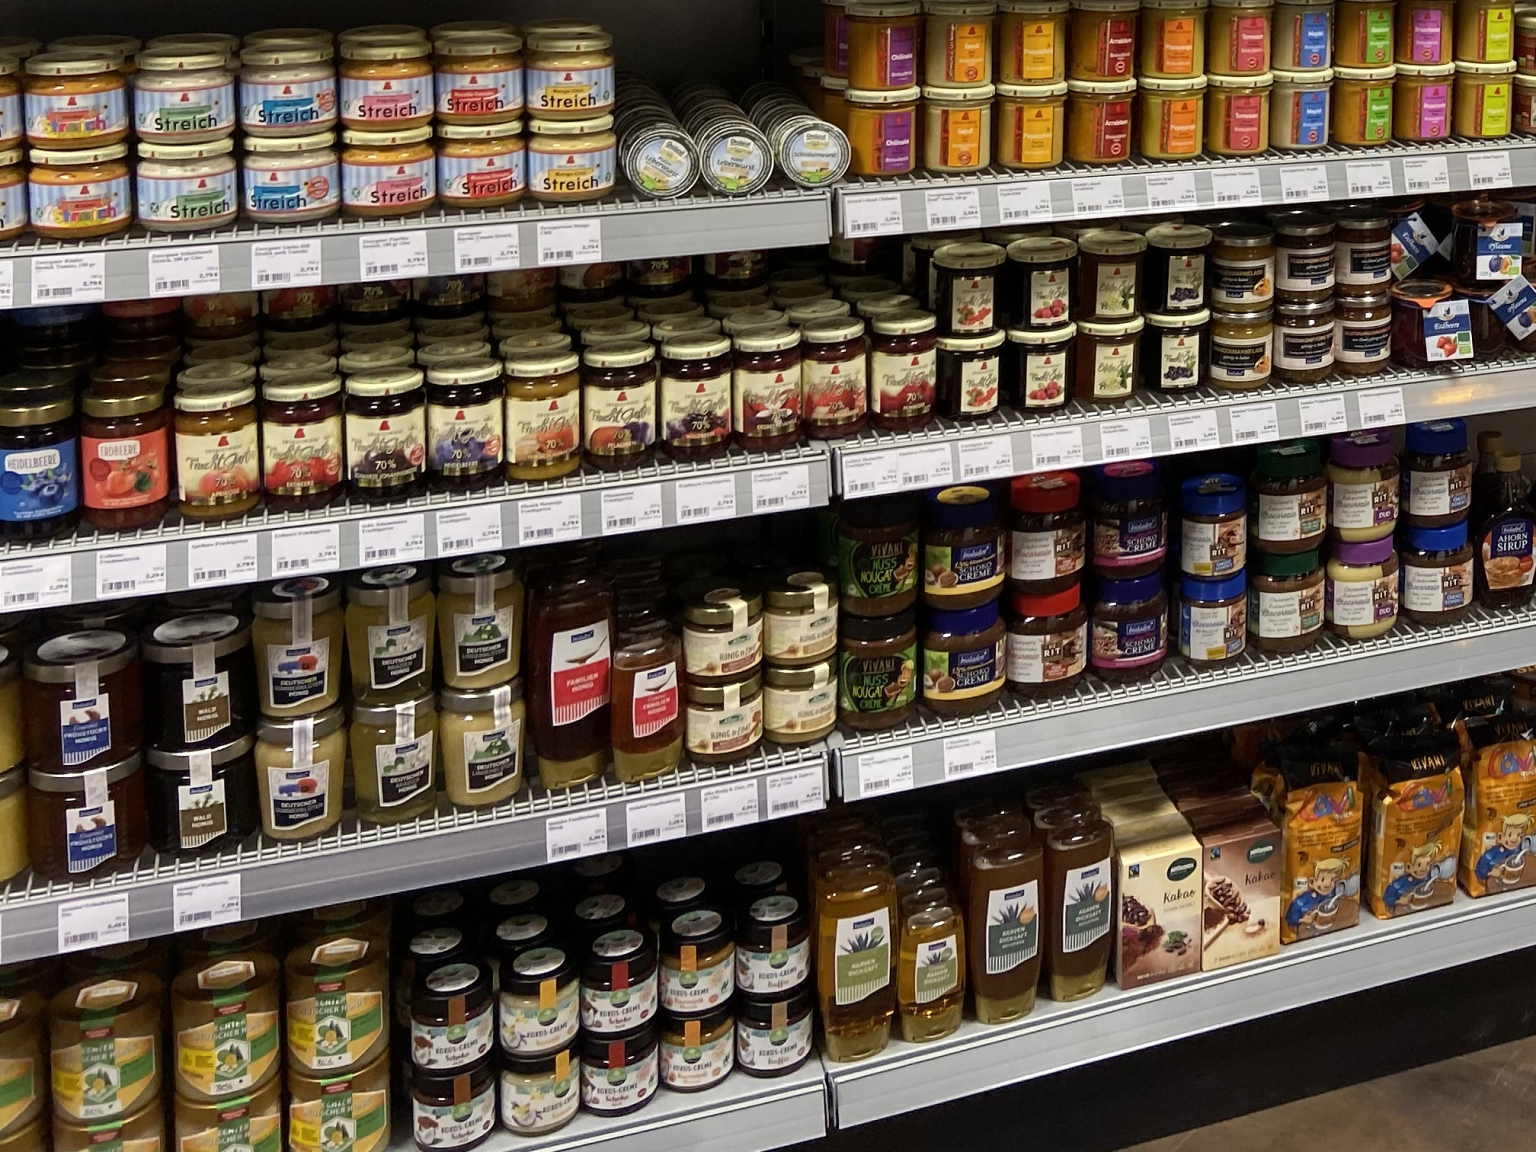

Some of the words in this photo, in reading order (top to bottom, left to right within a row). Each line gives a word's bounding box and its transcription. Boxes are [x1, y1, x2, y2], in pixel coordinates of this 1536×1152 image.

[447, 98, 504, 112] Streich
[540, 94, 597, 108] Streich
[258, 108, 319, 123] Streich
[358, 103, 417, 118] Streich
[41, 116, 107, 134] Streich
[154, 114, 217, 131] Streich
[462, 177, 517, 195] Streich
[543, 176, 599, 190] Streich
[371, 186, 427, 204] Streich
[170, 199, 230, 218] Streich
[250, 195, 307, 210] Streich
[52, 203, 117, 222] Streich
[692, 420, 710, 430] 70%
[545, 439, 564, 449] 70%
[100, 444, 138, 457] ERDBEERE
[451, 449, 471, 460] 70%
[7, 454, 57, 470] HEIDELBEERE
[375, 460, 396, 470] 70%
[290, 468, 311, 478] 70%
[1374, 493, 1388, 504] RIT
[1126, 534, 1158, 546] SCHOKO
[1498, 533, 1528, 543] AHORN
[1056, 542, 1071, 552] RIT
[1127, 541, 1158, 553] CREME
[1212, 547, 1226, 557] RIT
[1497, 540, 1528, 552] SIRUP
[959, 562, 992, 573] SCHOKO
[959, 569, 992, 581] CREME
[1443, 578, 1458, 588] RIT
[382, 653, 417, 665] DEUTSCHER
[566, 673, 598, 686] FAMILIEN
[864, 674, 888, 686] NUSS
[571, 681, 594, 692] HONIG
[852, 686, 884, 698] NOUGAT
[198, 706, 217, 714] WALD
[197, 712, 219, 722] HONIG
[1245, 871, 1276, 886] Kakao
[1163, 889, 1197, 904] Kakao
